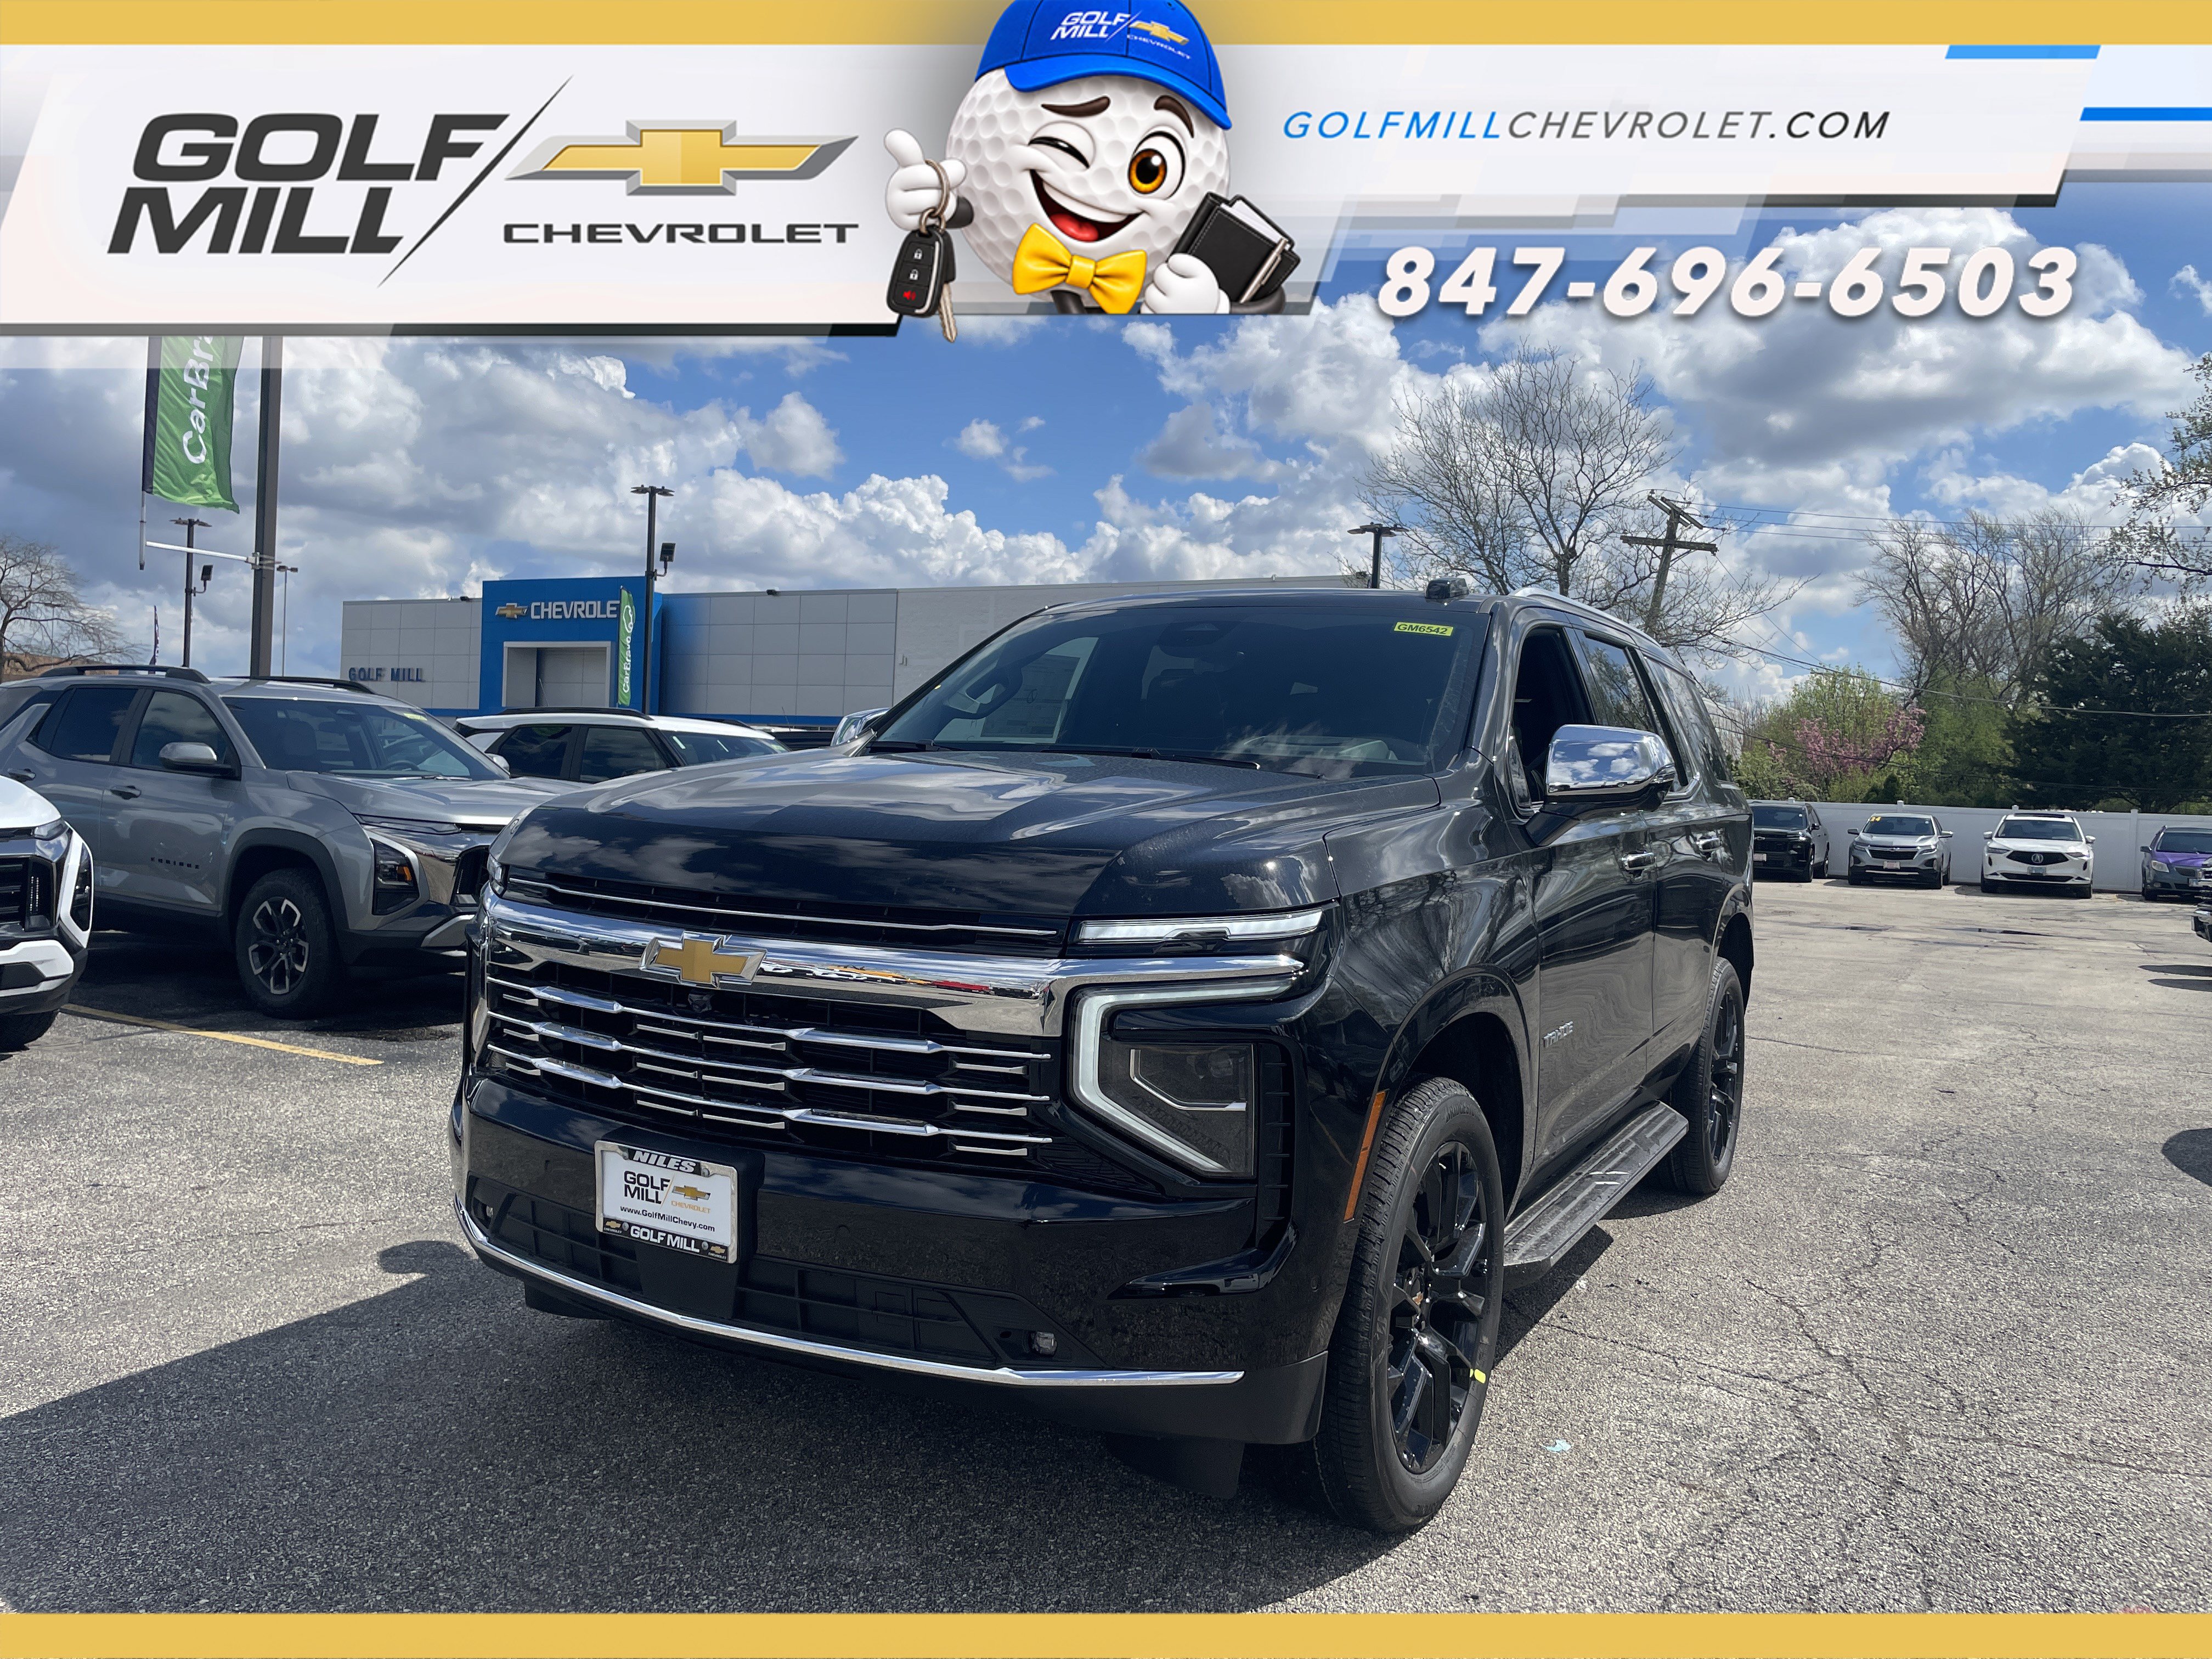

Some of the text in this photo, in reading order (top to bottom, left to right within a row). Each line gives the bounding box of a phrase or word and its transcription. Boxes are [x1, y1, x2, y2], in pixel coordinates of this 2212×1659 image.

[183, 336, 215, 464] CarBr
[531, 600, 620, 619] CHEVROLE
[1397, 624, 1448, 635] GM6542
[348, 667, 423, 682] GOLF MILL
[623, 636, 631, 693] CarBravo
[633, 1150, 696, 1173] NILES
[624, 1170, 670, 1191] GOLF
[624, 1183, 662, 1204] MILL
[671, 1200, 711, 1214] CHEVROLET
[620, 1206, 715, 1232] www.GolfMillChevy.com
[630, 1225, 700, 1252] GOLF MILL
